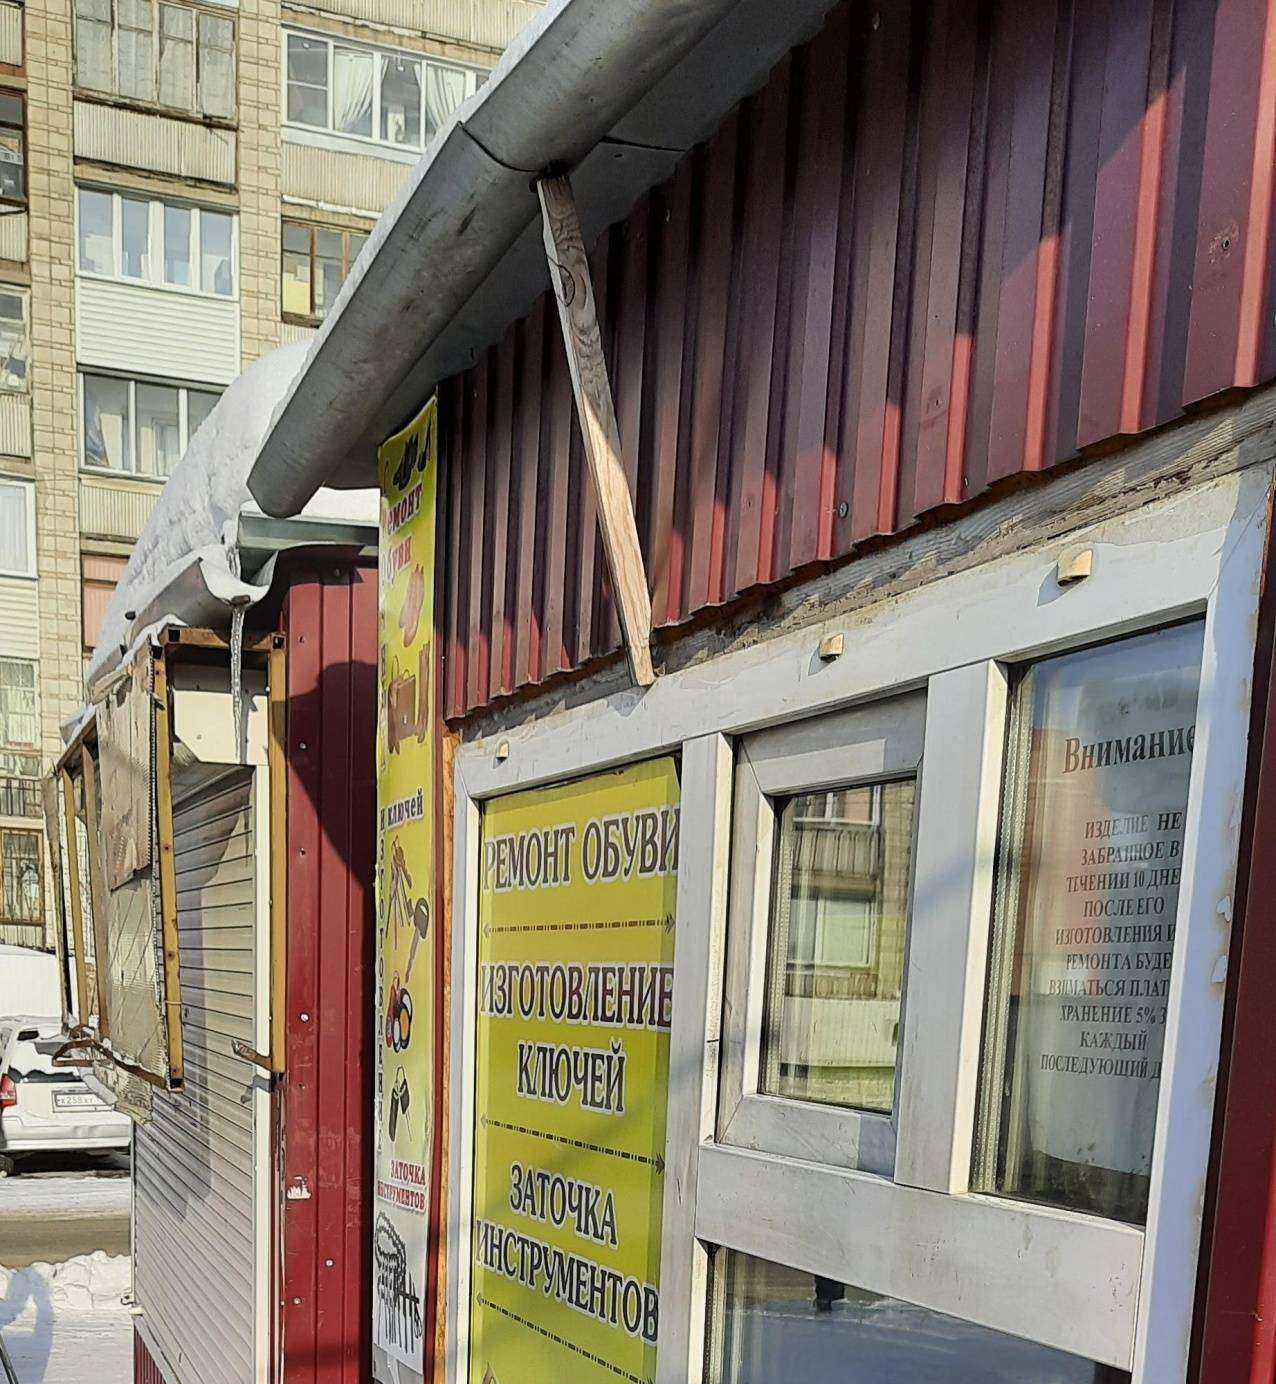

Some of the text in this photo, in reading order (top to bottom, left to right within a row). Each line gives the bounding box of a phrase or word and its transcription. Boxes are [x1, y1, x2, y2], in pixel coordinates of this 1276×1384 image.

[1062, 724, 1196, 774] Внимание
[1084, 811, 1183, 839] ИЗДЕЛИЕ НЕ
[483, 807, 681, 890] РЕМОНТ ОБУВИ
[1081, 839, 1182, 866] ЗАБРАННОЕ В
[1066, 870, 1131, 893] ТЕЧЕНИИ
[1133, 870, 1145, 888] 10
[1083, 896, 1165, 918] ПОСЛЕ ЕГО
[1055, 926, 1162, 947] ИЗГОТОВЛЕНИЯ
[1066, 952, 1131, 971] РЕМОНТА
[480, 963, 674, 1027] ИЗГОТОВЛЕНИЕ
[1050, 979, 1126, 998] ВЗИМАТЬСЯ
[1060, 1005, 1132, 1023] ХРАНЕНИЕ
[1136, 1006, 1156, 1025] 5%
[1080, 1030, 1148, 1051] КАЖДЫЙ
[517, 1040, 625, 1112] КЛЮЧЕЙ
[1041, 1053, 1148, 1079] ПОСЛЕДУЮЩИЙ
[390, 1159, 426, 1186] ЗАТОЧКА
[510, 1163, 617, 1246] ЗАТОЧКА
[476, 1219, 659, 1343] ИНСТРУМЕНТОВ
